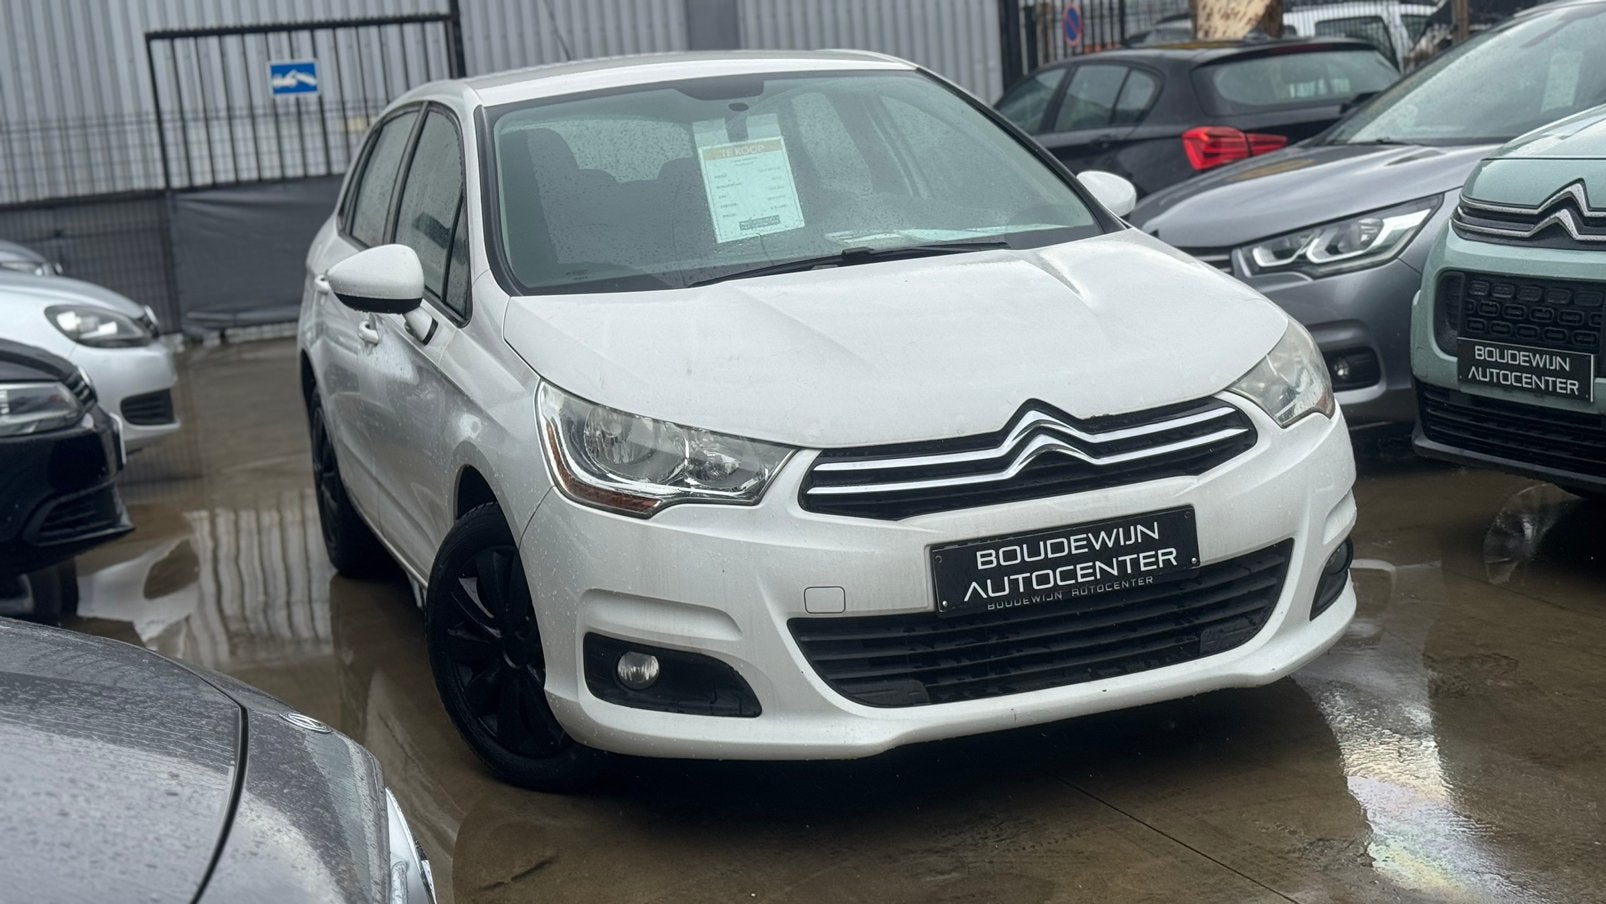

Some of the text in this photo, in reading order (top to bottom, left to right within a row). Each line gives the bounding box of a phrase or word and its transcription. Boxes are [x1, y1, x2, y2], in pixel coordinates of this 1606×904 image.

[735, 144, 765, 156] KOOP
[1475, 345, 1570, 371] BOUDEWIJN
[1468, 366, 1579, 395] AUTOCENTER
[976, 522, 1160, 570] BOUDEWIJN
[964, 547, 1178, 601] AUTOCENTER
[987, 576, 1154, 610] BOUDEWIJN AUTOCENTER
